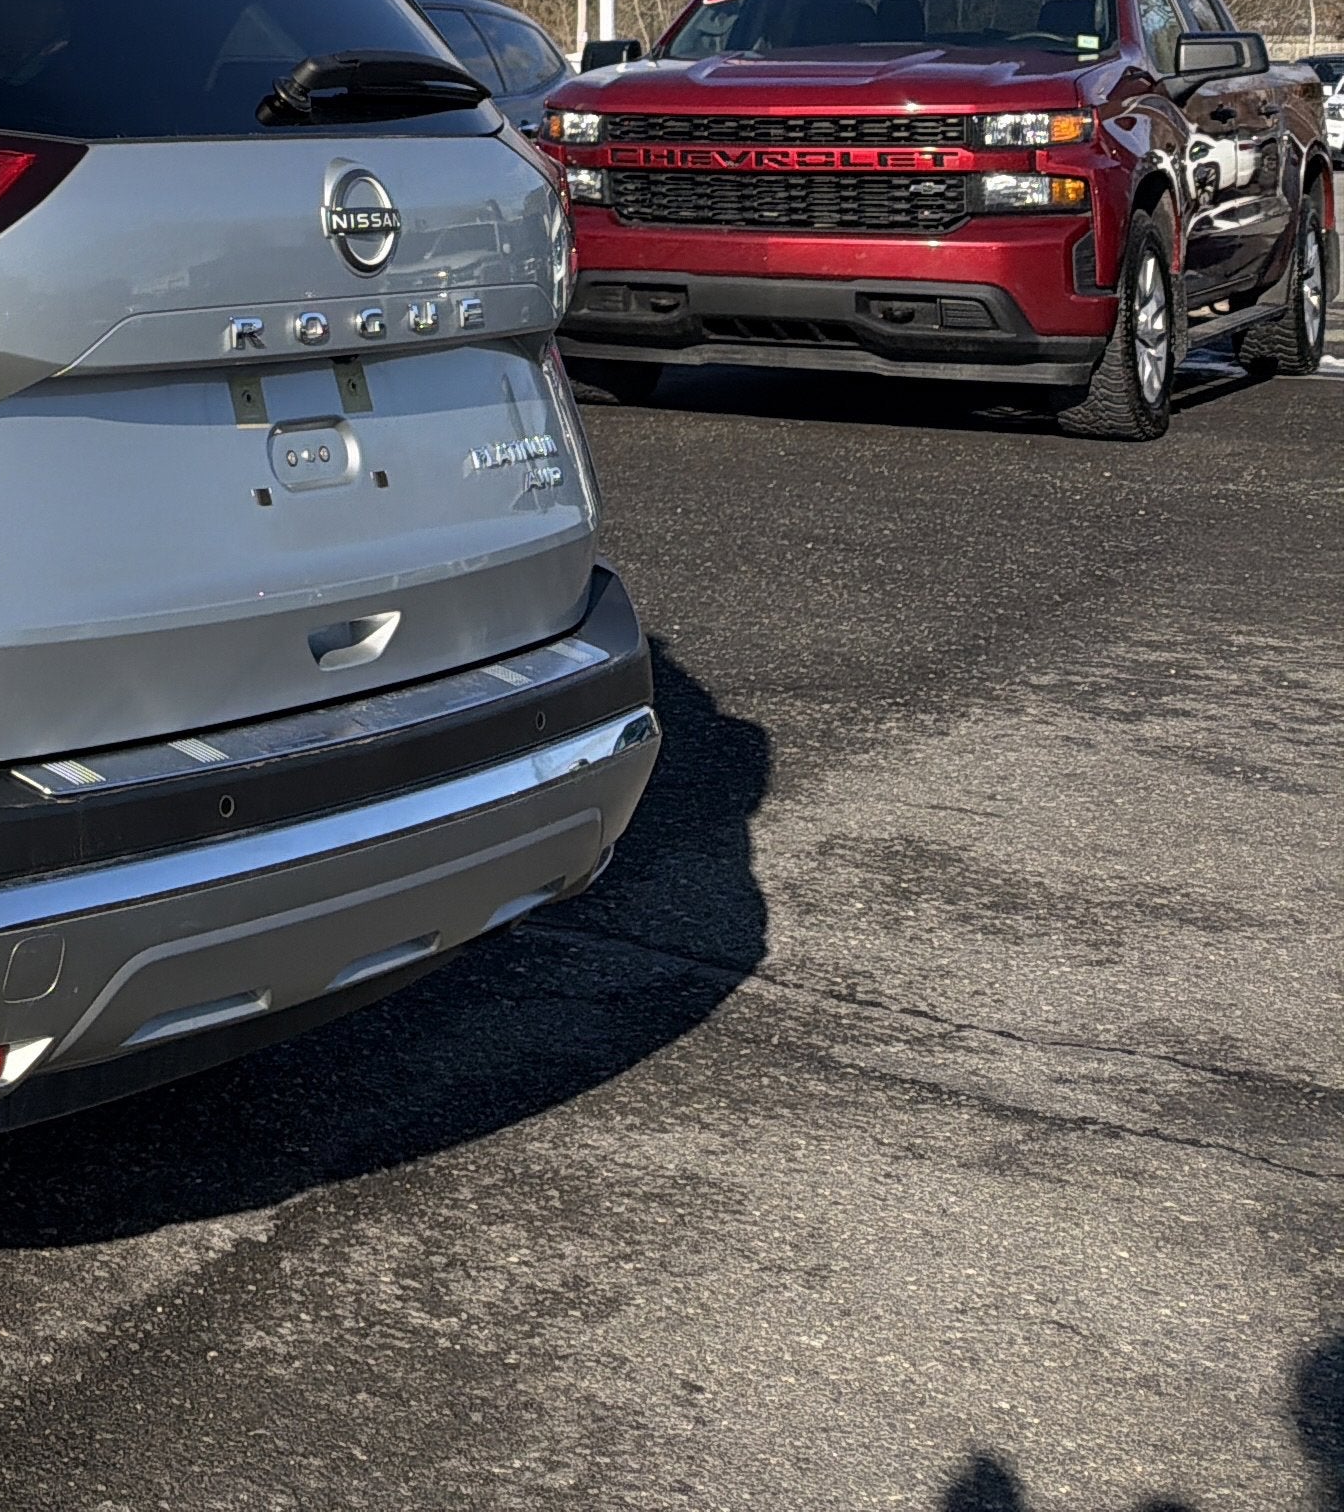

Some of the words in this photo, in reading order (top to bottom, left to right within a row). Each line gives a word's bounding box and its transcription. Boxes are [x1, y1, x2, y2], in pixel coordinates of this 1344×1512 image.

[610, 147, 960, 169] CHEVROLET
[332, 208, 401, 231] NISSAN
[227, 298, 485, 350] ROGUE
